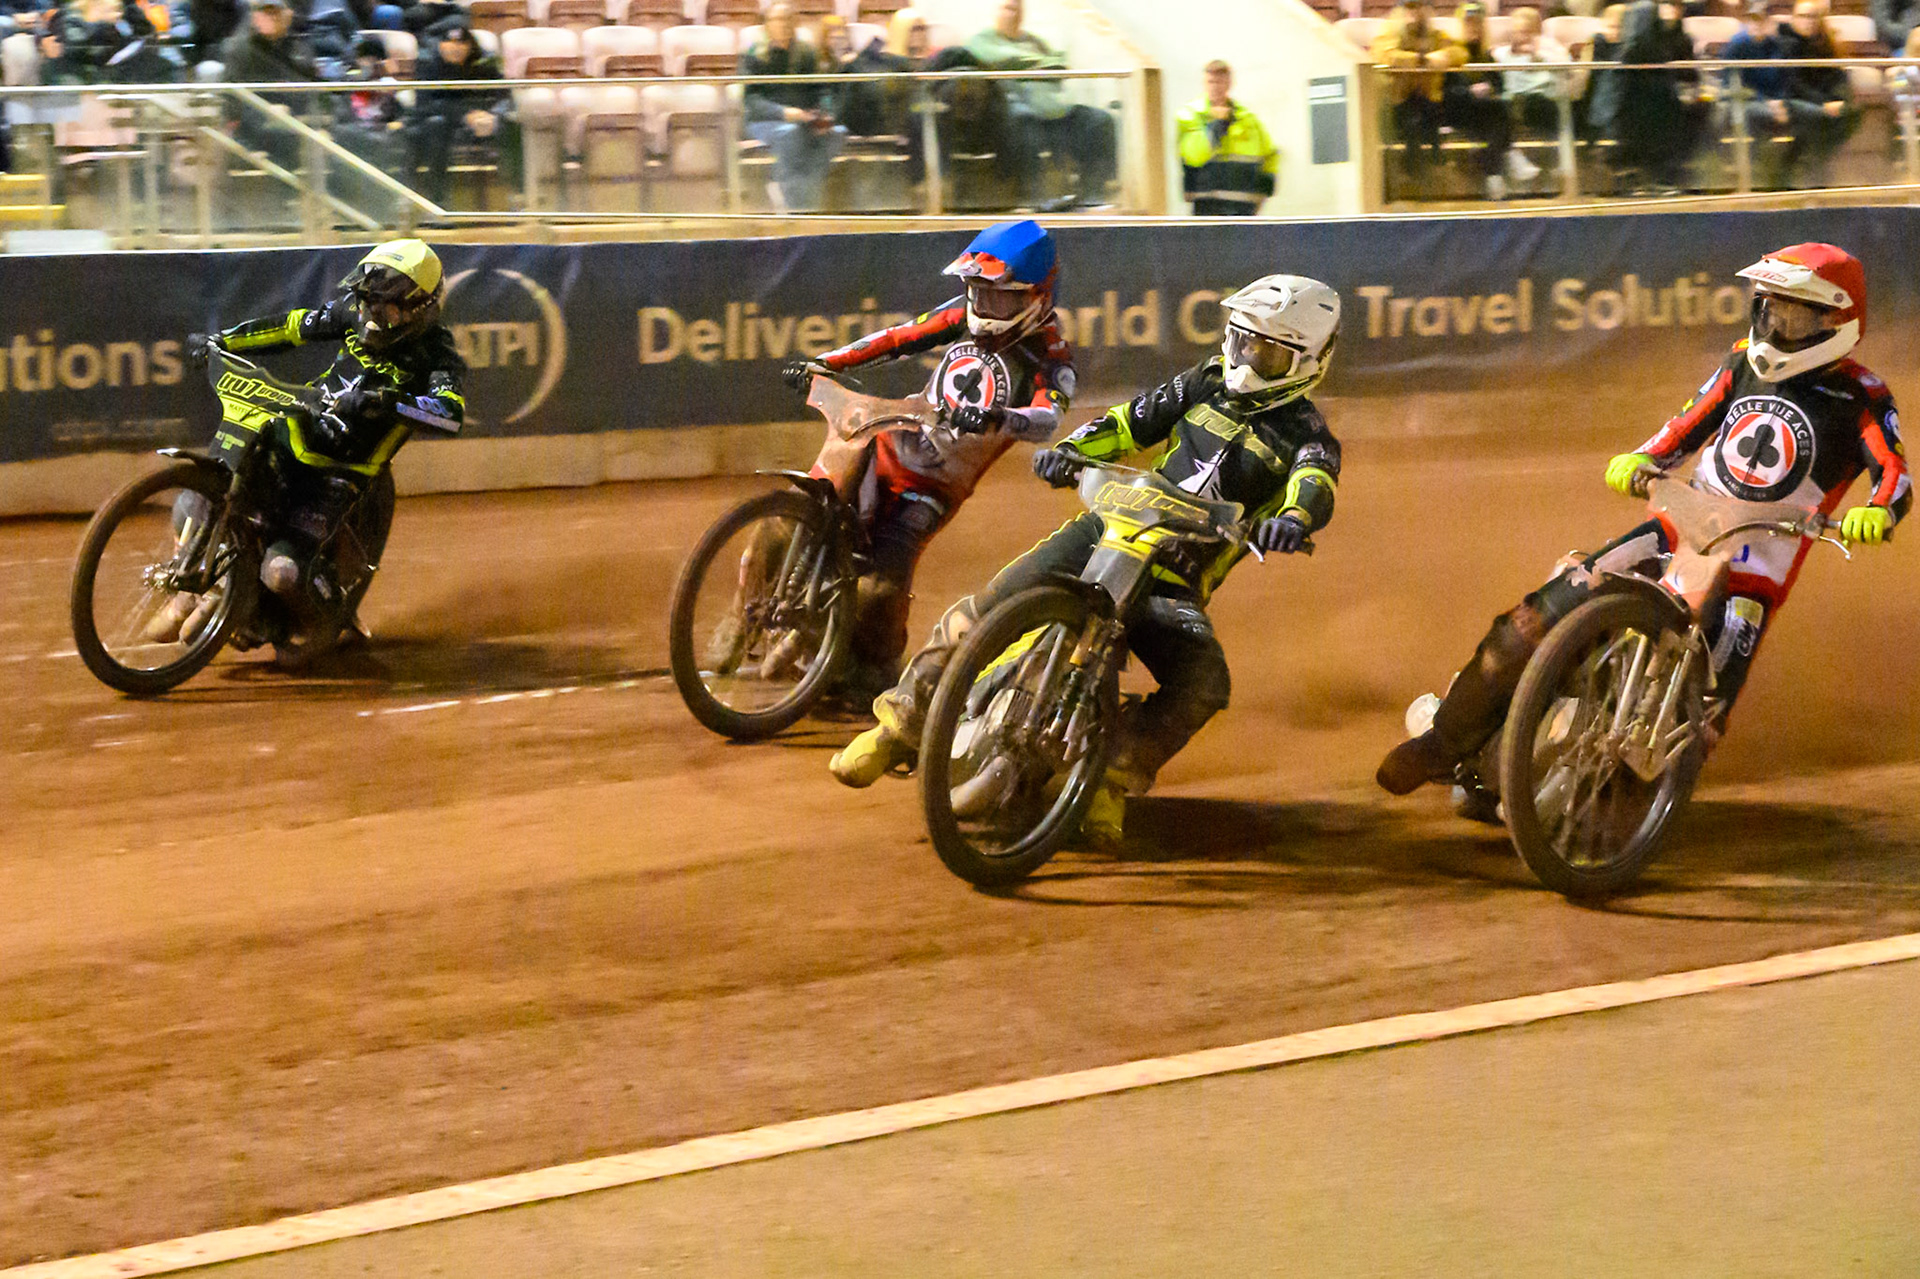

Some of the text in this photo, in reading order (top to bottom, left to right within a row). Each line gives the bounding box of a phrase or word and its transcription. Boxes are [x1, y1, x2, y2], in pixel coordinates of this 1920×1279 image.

[637, 297, 943, 370] Deliveri
[1053, 289, 1160, 347] orld
[1354, 277, 1534, 338] Travel
[1552, 271, 1752, 331] Solutio
[949, 346, 979, 361] BELLE
[996, 374, 1007, 402] ACES
[1727, 402, 1810, 456] BELLE VUE ACES
